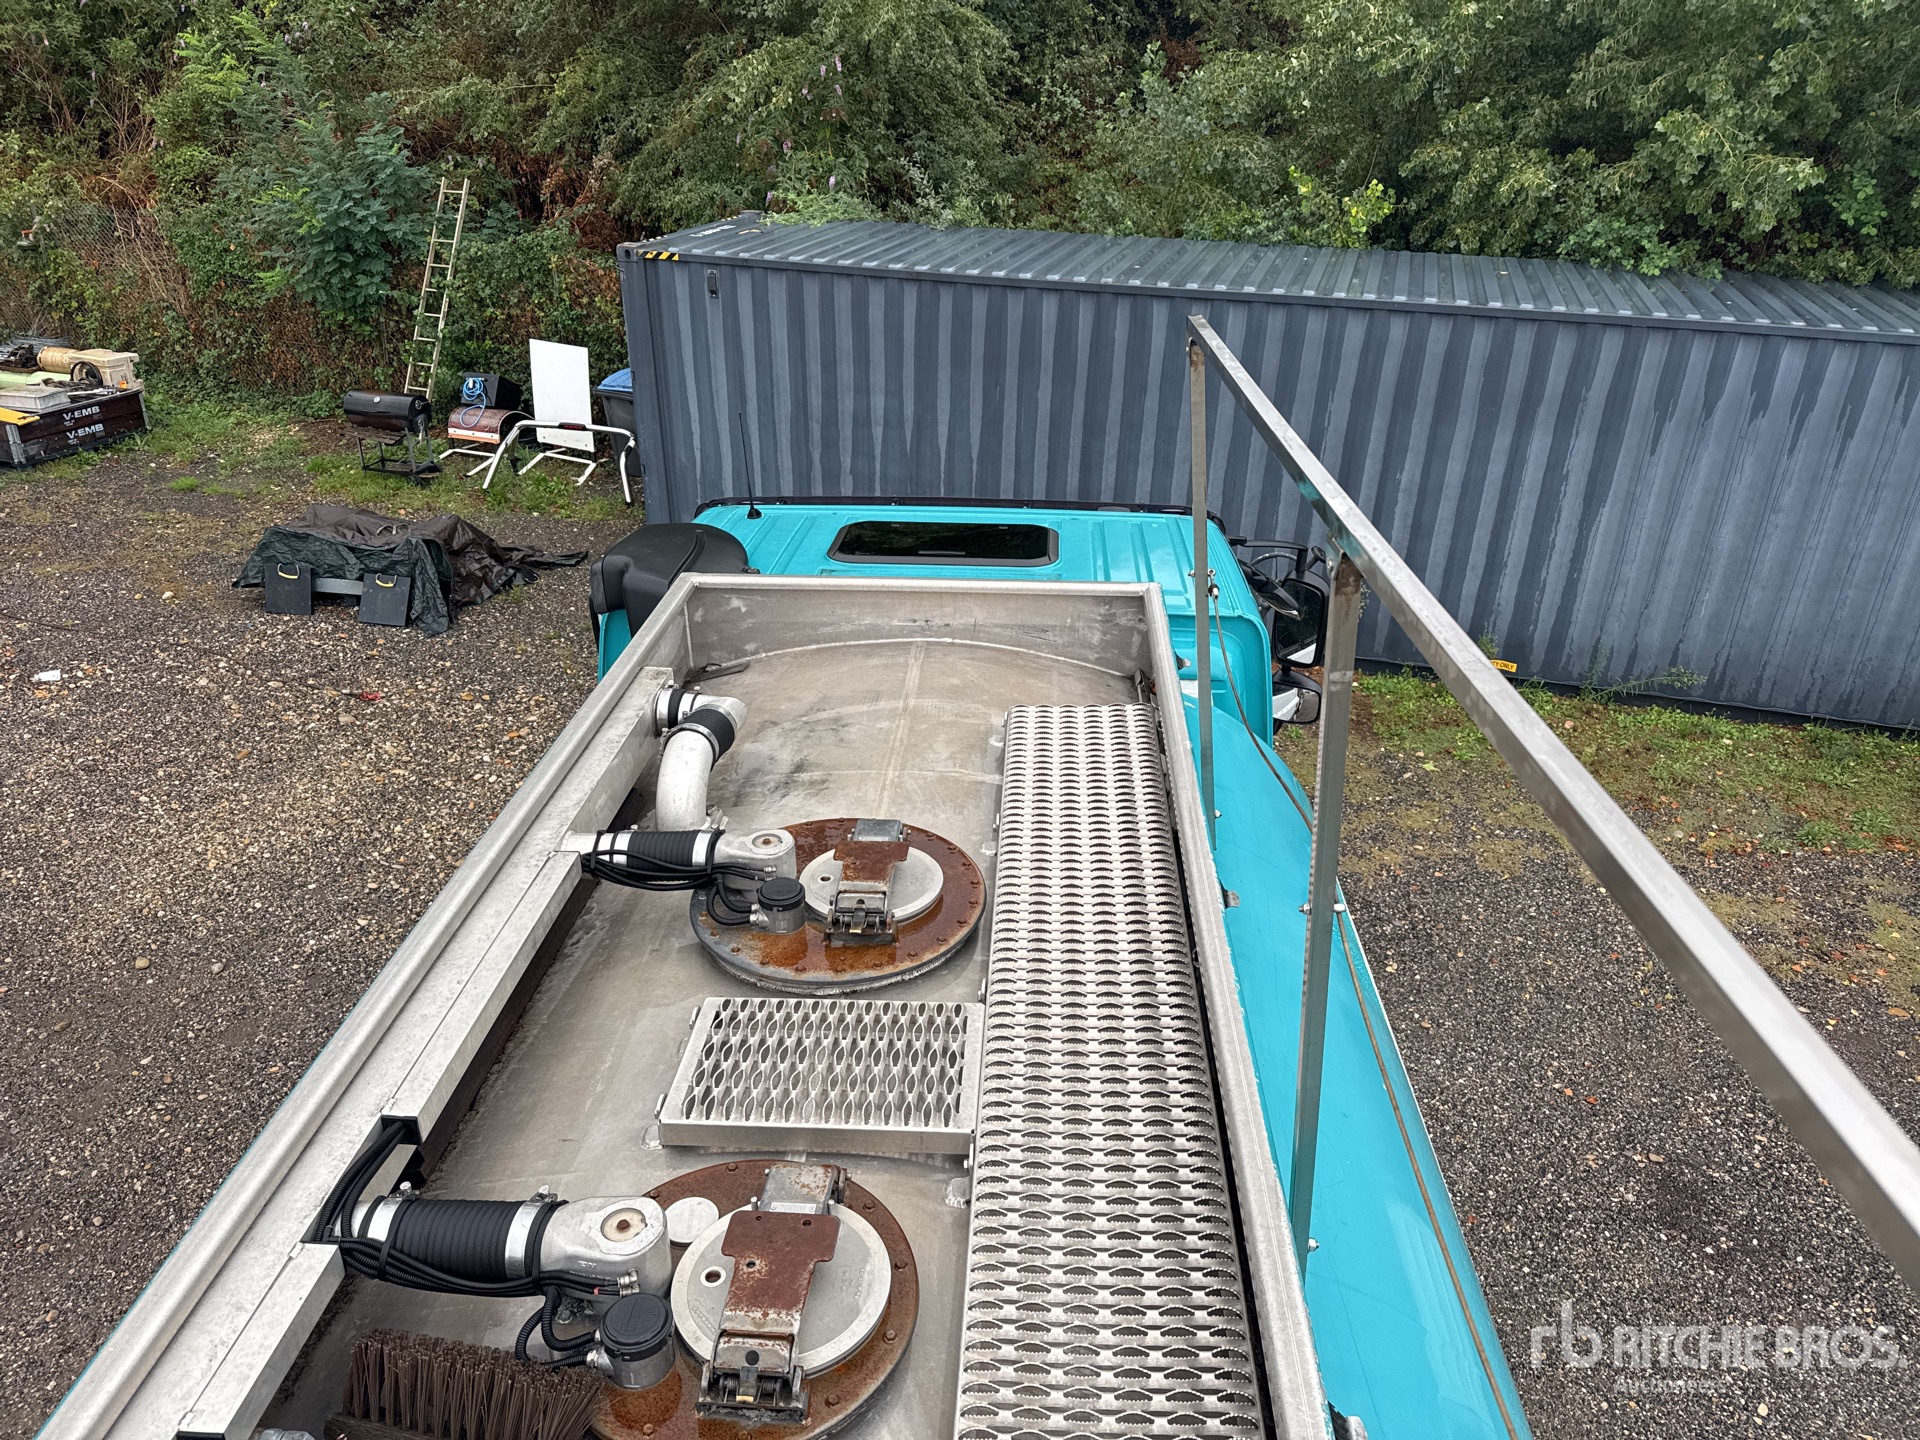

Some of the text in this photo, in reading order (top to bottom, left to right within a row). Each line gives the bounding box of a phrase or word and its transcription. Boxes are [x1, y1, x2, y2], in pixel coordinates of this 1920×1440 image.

[63, 406, 100, 420] V-EMB
[66, 424, 104, 438] V-EMB
[1500, 662, 1514, 670] ONLY
